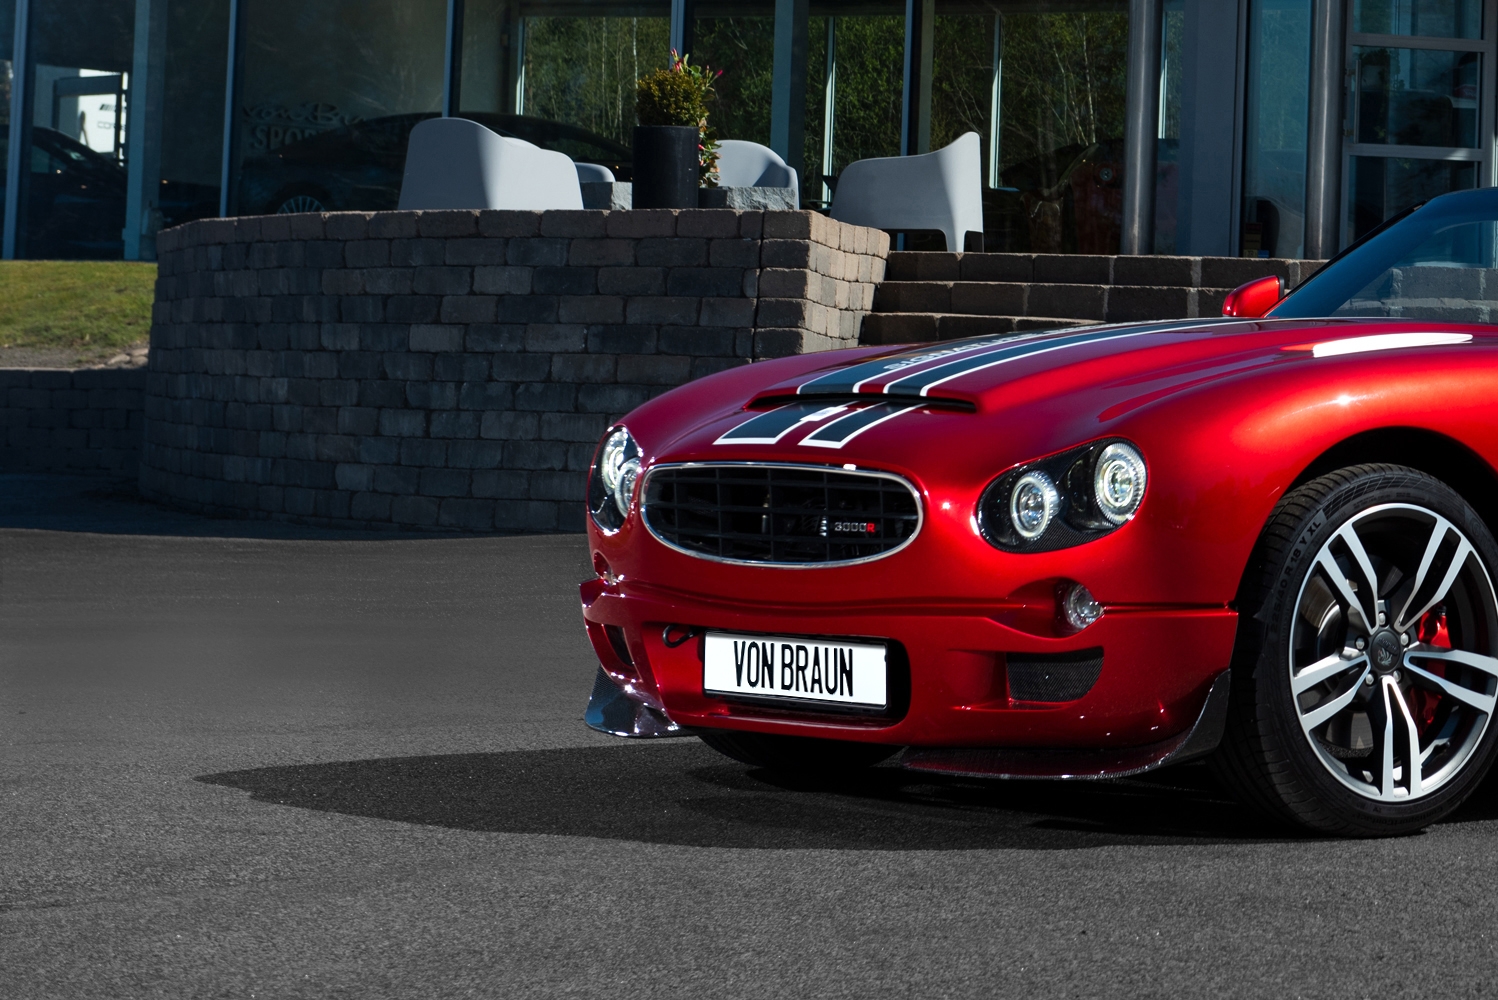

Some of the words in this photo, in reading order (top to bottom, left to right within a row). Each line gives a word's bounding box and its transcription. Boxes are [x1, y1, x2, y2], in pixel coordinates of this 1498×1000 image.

[834, 521, 876, 534] 3000R
[1284, 566, 1293, 576] R
[1290, 548, 1302, 563] 18
[1299, 535, 1308, 545] Y
[1307, 521, 1322, 536] XL
[733, 640, 775, 689] VON
[780, 643, 854, 697] BRAUN
